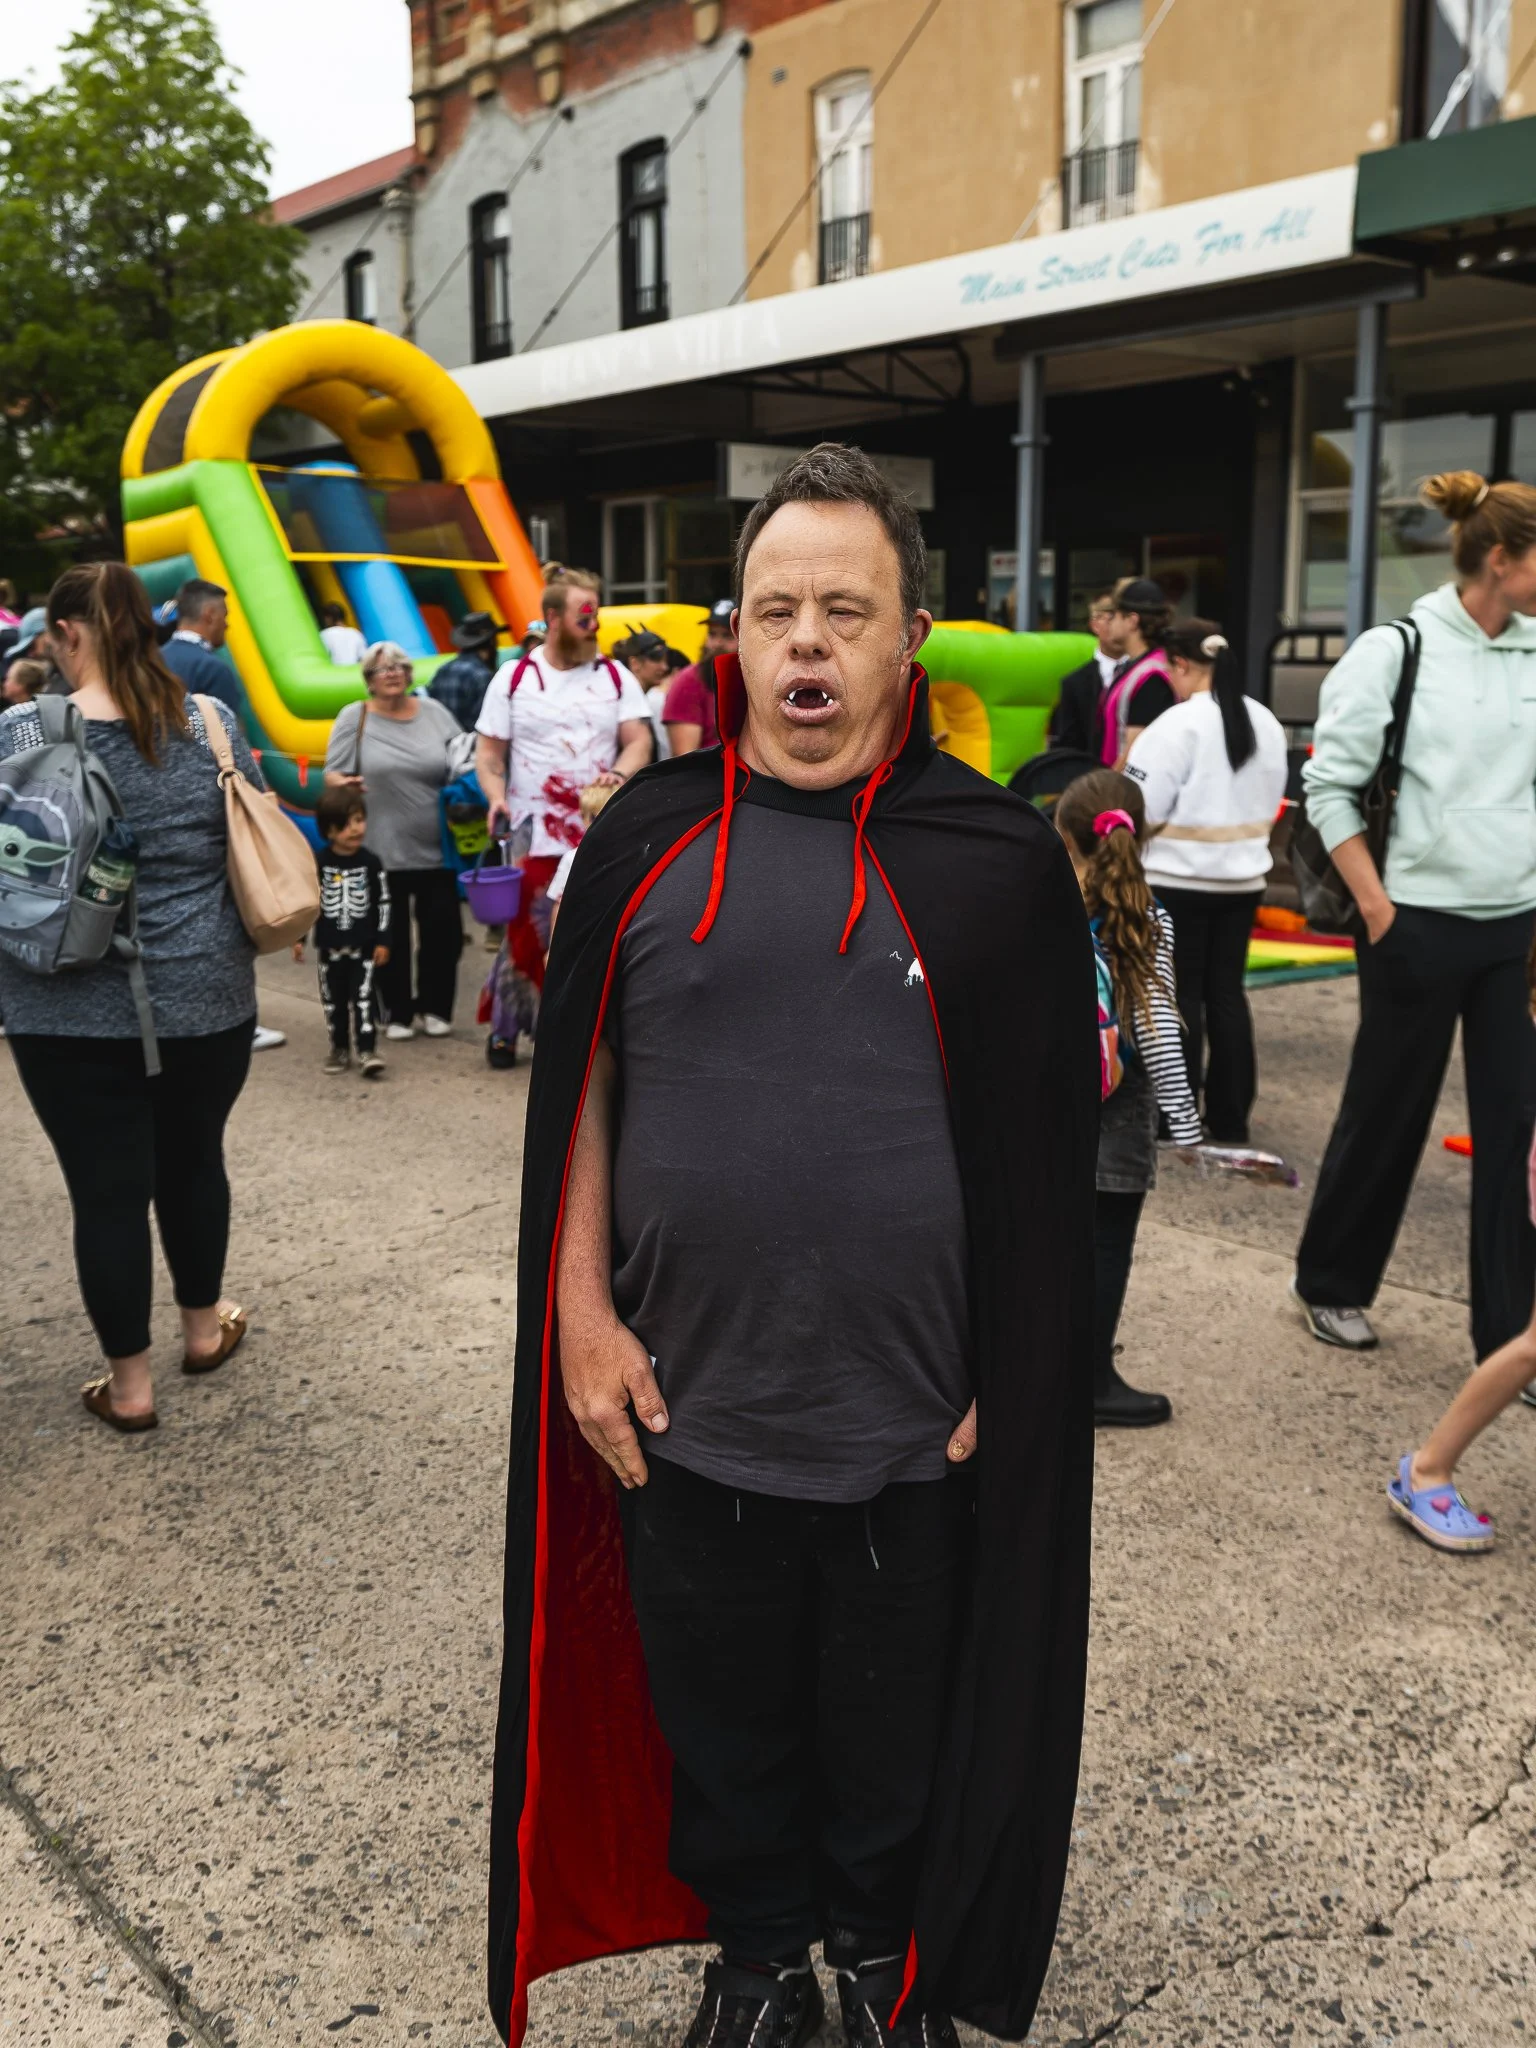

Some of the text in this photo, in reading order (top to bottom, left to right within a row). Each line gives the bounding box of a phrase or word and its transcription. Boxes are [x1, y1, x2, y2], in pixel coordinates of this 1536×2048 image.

[960, 207, 1315, 304] Main Street Cuts For All
